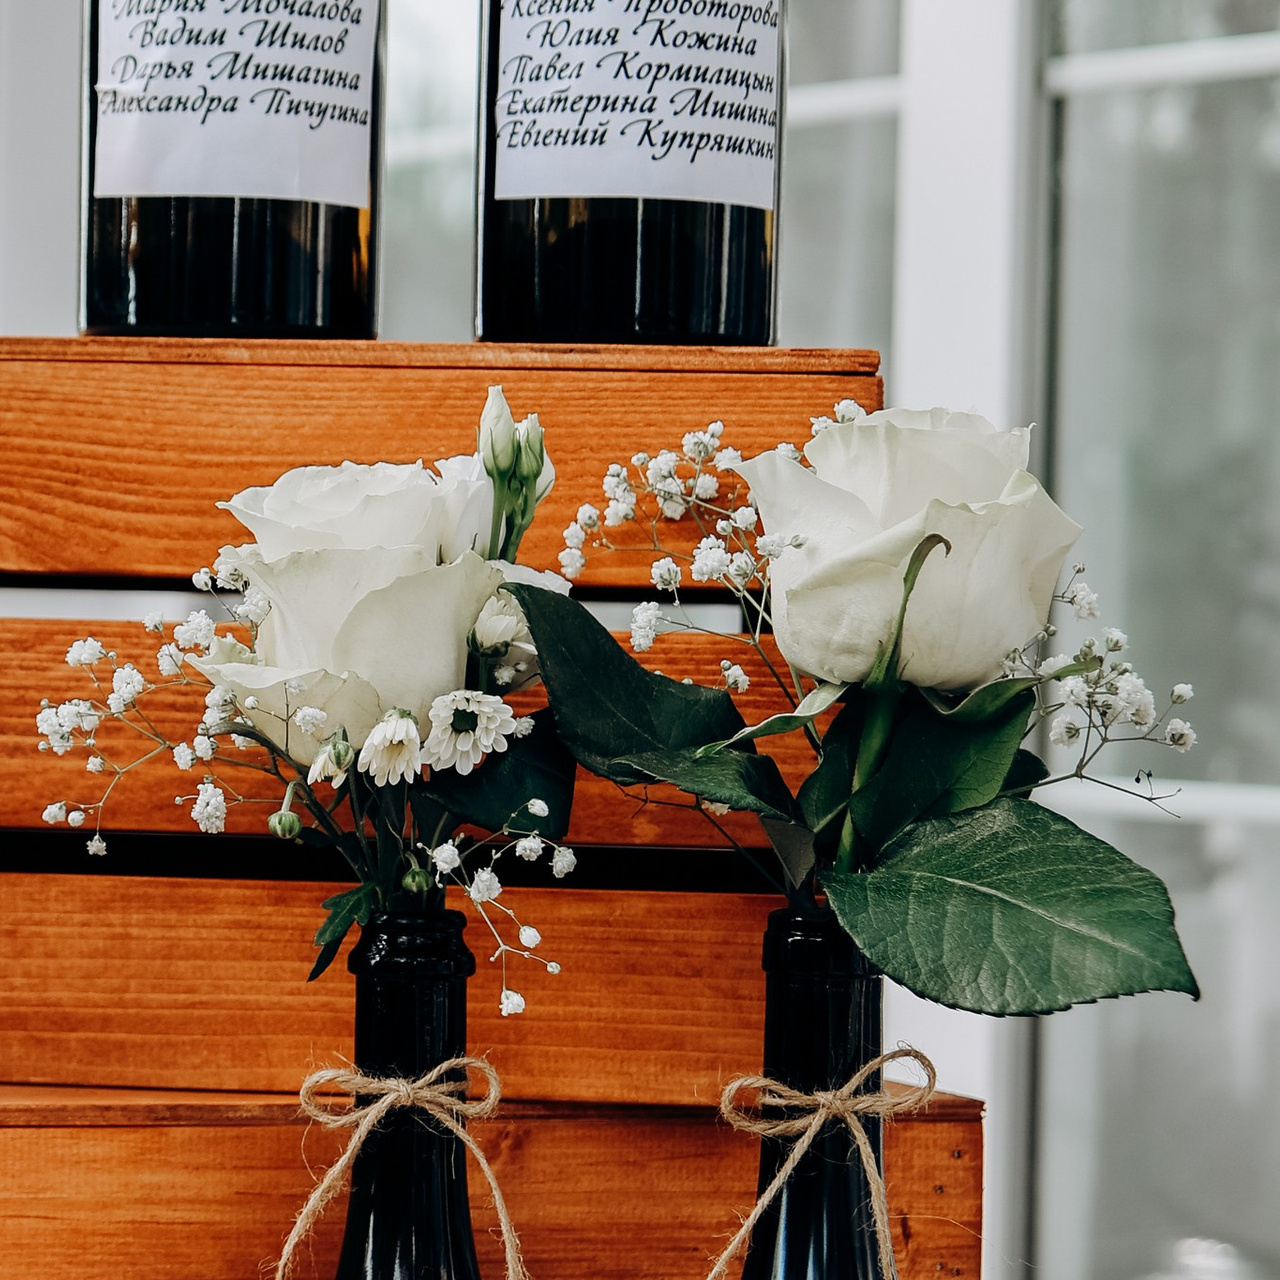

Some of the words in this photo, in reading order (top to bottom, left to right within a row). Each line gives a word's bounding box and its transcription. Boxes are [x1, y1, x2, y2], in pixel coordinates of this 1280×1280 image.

[129, 18, 226, 49] Вадим
[239, 20, 349, 54] Шилов
[526, 19, 620, 47] Юлия
[633, 19, 757, 55] Кожина
[111, 55, 194, 92] Дарья
[207, 52, 360, 91] Мишагина
[502, 52, 584, 84] Павел
[596, 51, 774, 99] Кормилицын
[99, 85, 238, 125] Александра
[250, 87, 369, 130] Пичугина
[496, 86, 657, 126] Екатерина
[670, 88, 776, 126] Мишина
[497, 119, 608, 148] Евгений
